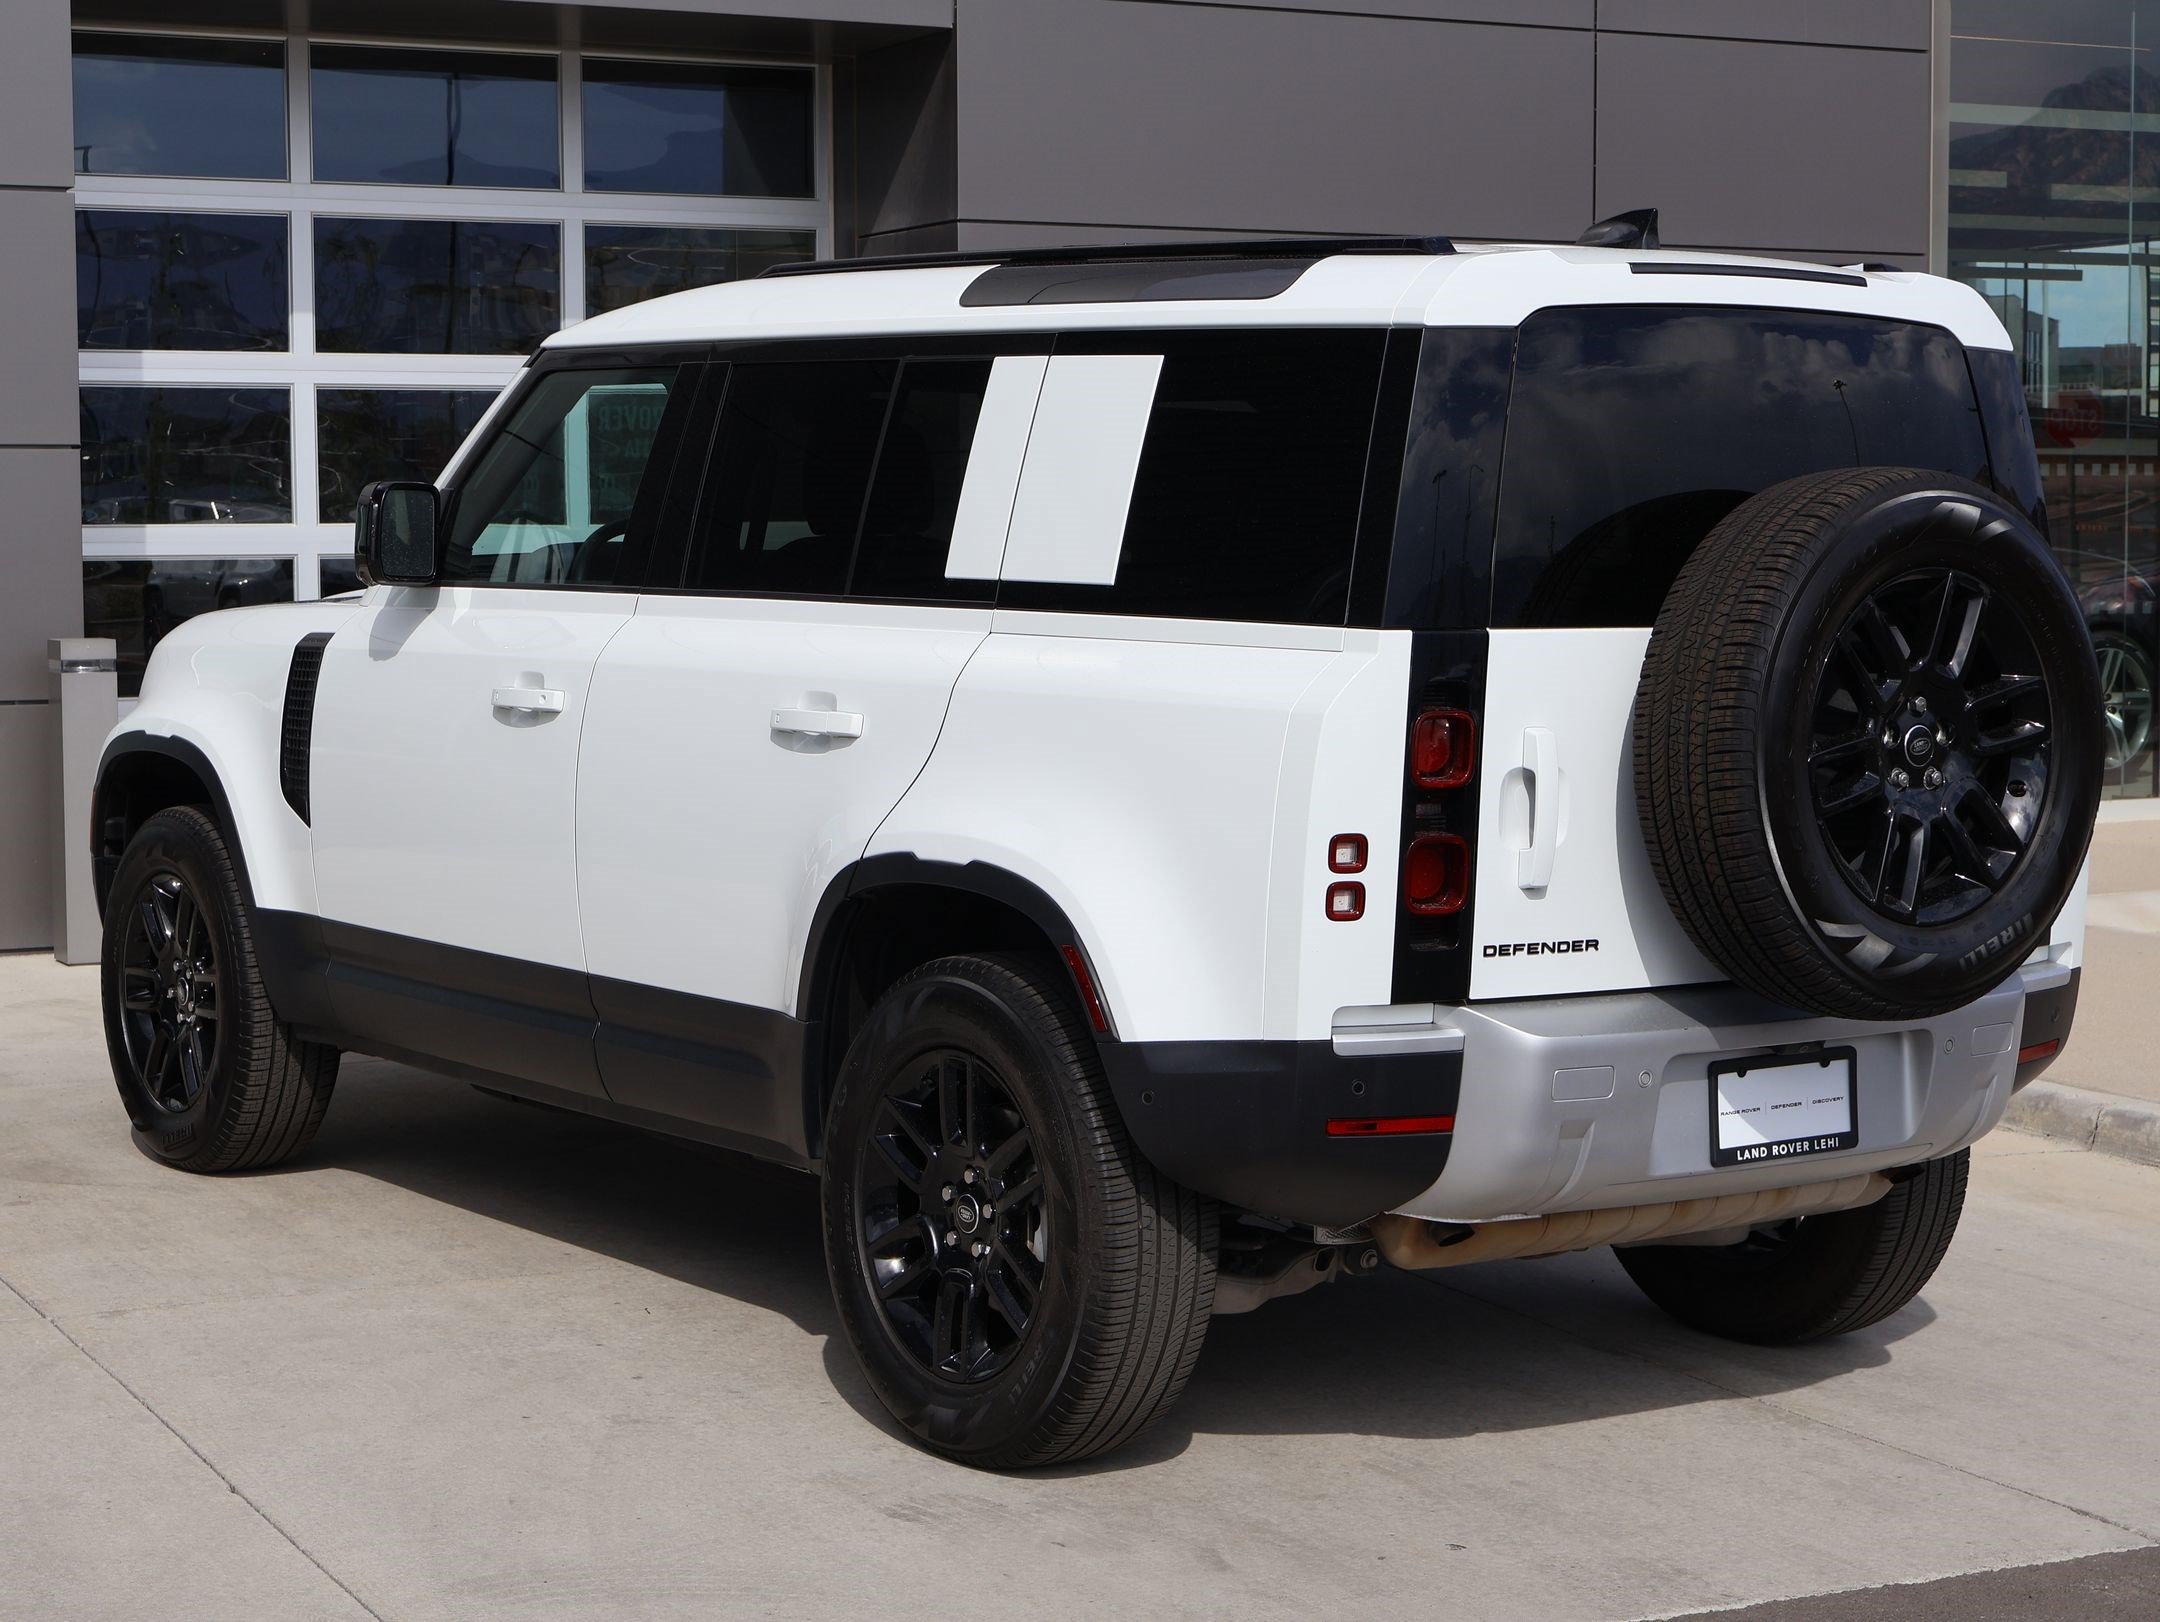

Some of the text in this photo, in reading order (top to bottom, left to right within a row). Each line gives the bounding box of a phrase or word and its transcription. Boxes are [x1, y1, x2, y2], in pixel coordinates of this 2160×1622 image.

[1483, 939, 1600, 957] DEFENDER
[1771, 1102, 1802, 1110] DEFENDER
[1812, 1096, 1844, 1105] DISCOVERY
[1737, 1137, 1839, 1160] LAND ROVER LEHI
